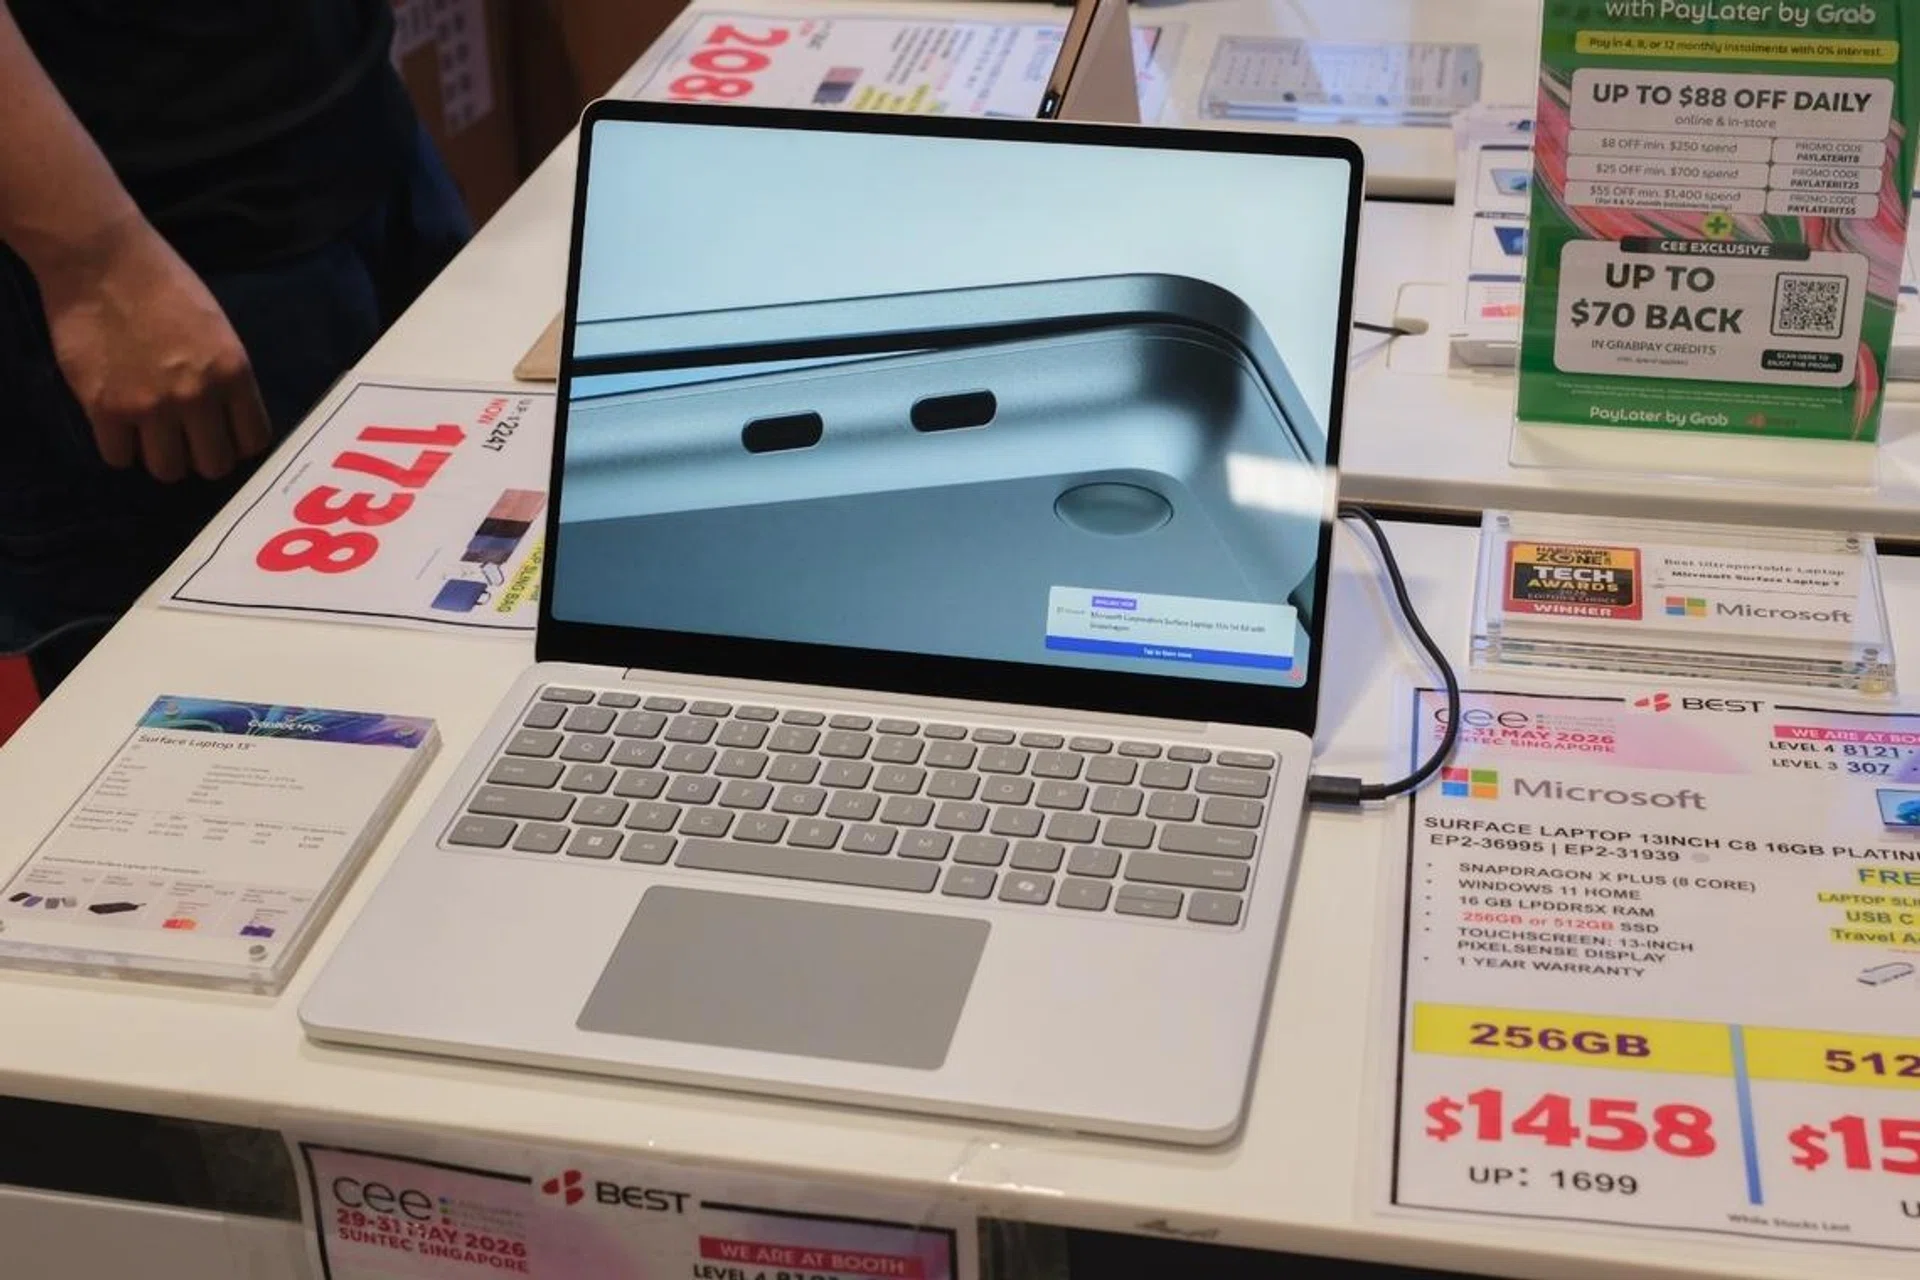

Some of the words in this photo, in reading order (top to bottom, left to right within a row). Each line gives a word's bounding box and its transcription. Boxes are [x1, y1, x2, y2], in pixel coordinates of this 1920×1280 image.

[1605, 0, 1656, 18] with
[1660, 0, 1771, 24] PayLater
[1778, 2, 1810, 27] by
[1816, 3, 1877, 24] Grab
[1589, 38, 1610, 49] Pay
[1612, 38, 1624, 48] in
[1676, 40, 1722, 54] monthly
[1790, 45, 1816, 55] with
[665, 25, 790, 103] 208
[1592, 83, 1630, 104] UP
[1636, 85, 1672, 106] TO
[1679, 85, 1727, 108] $88
[1734, 88, 1787, 110] OFF
[1793, 91, 1872, 112] DAILY
[1674, 114, 1714, 127] online
[1716, 116, 1725, 127] &
[1727, 117, 1777, 129] in-store
[1601, 137, 1617, 150] $8
[1618, 139, 1641, 150] OFF
[1671, 141, 1699, 153] $250
[1701, 142, 1738, 155] spend
[1795, 142, 1832, 152] PROMO
[1834, 143, 1863, 153] CODE
[1618, 165, 1643, 177] OFF
[1671, 167, 1700, 179] $700
[1701, 168, 1739, 181] spend
[1792, 168, 1830, 178] PROMO
[1832, 169, 1860, 180] CODE
[1612, 186, 1636, 198] OFF
[1704, 190, 1742, 202] spend
[1789, 194, 1828, 204] PROMO
[1829, 195, 1857, 205] CODE
[1660, 241, 1688, 253] CEE
[1690, 243, 1770, 256] EXCLUSIVE
[1605, 263, 1655, 289] UP
[1665, 266, 1715, 292] TO
[1570, 297, 1636, 328] $70
[1645, 304, 1743, 334] BACK
[1592, 339, 1605, 349] IN
[1606, 341, 1662, 354] GRABPAY
[1664, 343, 1717, 355] CREDITS
[1589, 406, 1662, 423] PayLater
[1665, 410, 1686, 427] by
[1690, 412, 1729, 427] Grab
[256, 424, 466, 574] 1738
[1527, 579, 1619, 592] AWARDS
[1532, 566, 1615, 583] TECH
[1671, 570, 1732, 580] Microsoft
[1786, 578, 1830, 588] Laptop
[1533, 604, 1612, 617] WINNER
[1715, 602, 1853, 624] Microsoft
[1682, 698, 1766, 713] BEST
[1434, 707, 1529, 728] cee
[139, 734, 187, 746] Surface
[189, 739, 234, 750] Laptop
[1501, 730, 1551, 741] MAY
[1556, 733, 1615, 744] 2026
[1510, 738, 1616, 753] SINGAPORE
[1791, 728, 1821, 739] WE
[1824, 730, 1859, 741] ARE
[1864, 732, 1884, 742] AT
[1891, 734, 1920, 745] BO
[1769, 741, 1820, 753] LEVEL
[1823, 743, 1835, 753] 4
[1843, 745, 1899, 758] 8121
[1772, 759, 1822, 770] LEVEL
[1827, 761, 1838, 771] 3
[1847, 761, 1890, 775] 307
[1513, 778, 1707, 810] Microsoft
[1425, 816, 1532, 835] SURFACE
[1539, 826, 1632, 842] LAPTOP
[1640, 833, 1720, 849] 13INCH
[1728, 839, 1758, 852] C8
[1766, 842, 1825, 856] 16GB
[1833, 846, 1920, 862] PLATIN
[1430, 833, 1544, 852] EP2-36995
[1564, 843, 1681, 862] EP2-31939
[1459, 862, 1592, 881] SNAPDRAGON
[1599, 870, 1611, 882] X
[1617, 872, 1667, 887] PLUS
[1672, 874, 1689, 889] (8
[1695, 876, 1756, 893] CORE)
[1458, 878, 1553, 896] WINDOWS
[1561, 884, 1578, 897] 11
[1584, 886, 1642, 901] HOME
[1817, 892, 1886, 905] LAPTOP
[1890, 896, 1920, 907] SLI
[1459, 895, 1479, 907] 16
[1484, 896, 1512, 909] GB
[1518, 898, 1608, 916] LPDDR5X
[1613, 904, 1656, 919] RAM
[1846, 910, 1893, 924] USB
[1899, 912, 1914, 925] C
[1462, 911, 1523, 926] 256GB
[1529, 916, 1548, 927] or
[1553, 917, 1616, 931] 512GB
[1620, 921, 1660, 935] SSD
[1458, 926, 1613, 948] TOUCHSCREEN:
[1619, 936, 1695, 953] 13-INCH
[1831, 927, 1895, 943] Travel
[1457, 939, 1580, 958] PIXELSENSE
[1584, 947, 1667, 964] DISPLAY
[1458, 956, 1467, 967] 1
[1473, 957, 1526, 971] YEAR
[1532, 959, 1646, 979] WARRANTY
[1469, 1022, 1652, 1058] 256GB
[1825, 1047, 1920, 1078] 512
[1424, 1086, 1718, 1159] $1458
[1788, 1114, 1920, 1176] $15
[1468, 1165, 1530, 1188] UP:
[1550, 1169, 1638, 1196] 1699
[333, 1176, 433, 1221] cee
[594, 1180, 692, 1215] BEST
[336, 1208, 402, 1234] 29-31
[406, 1221, 458, 1244] MAY
[464, 1232, 528, 1258] 2026
[338, 1226, 413, 1253] SUNTEC
[418, 1241, 530, 1274] SINGAPORE
[719, 1242, 752, 1259] WE
[756, 1247, 795, 1265] ARE
[801, 1251, 823, 1267] AT
[832, 1254, 905, 1275] BOOTH
